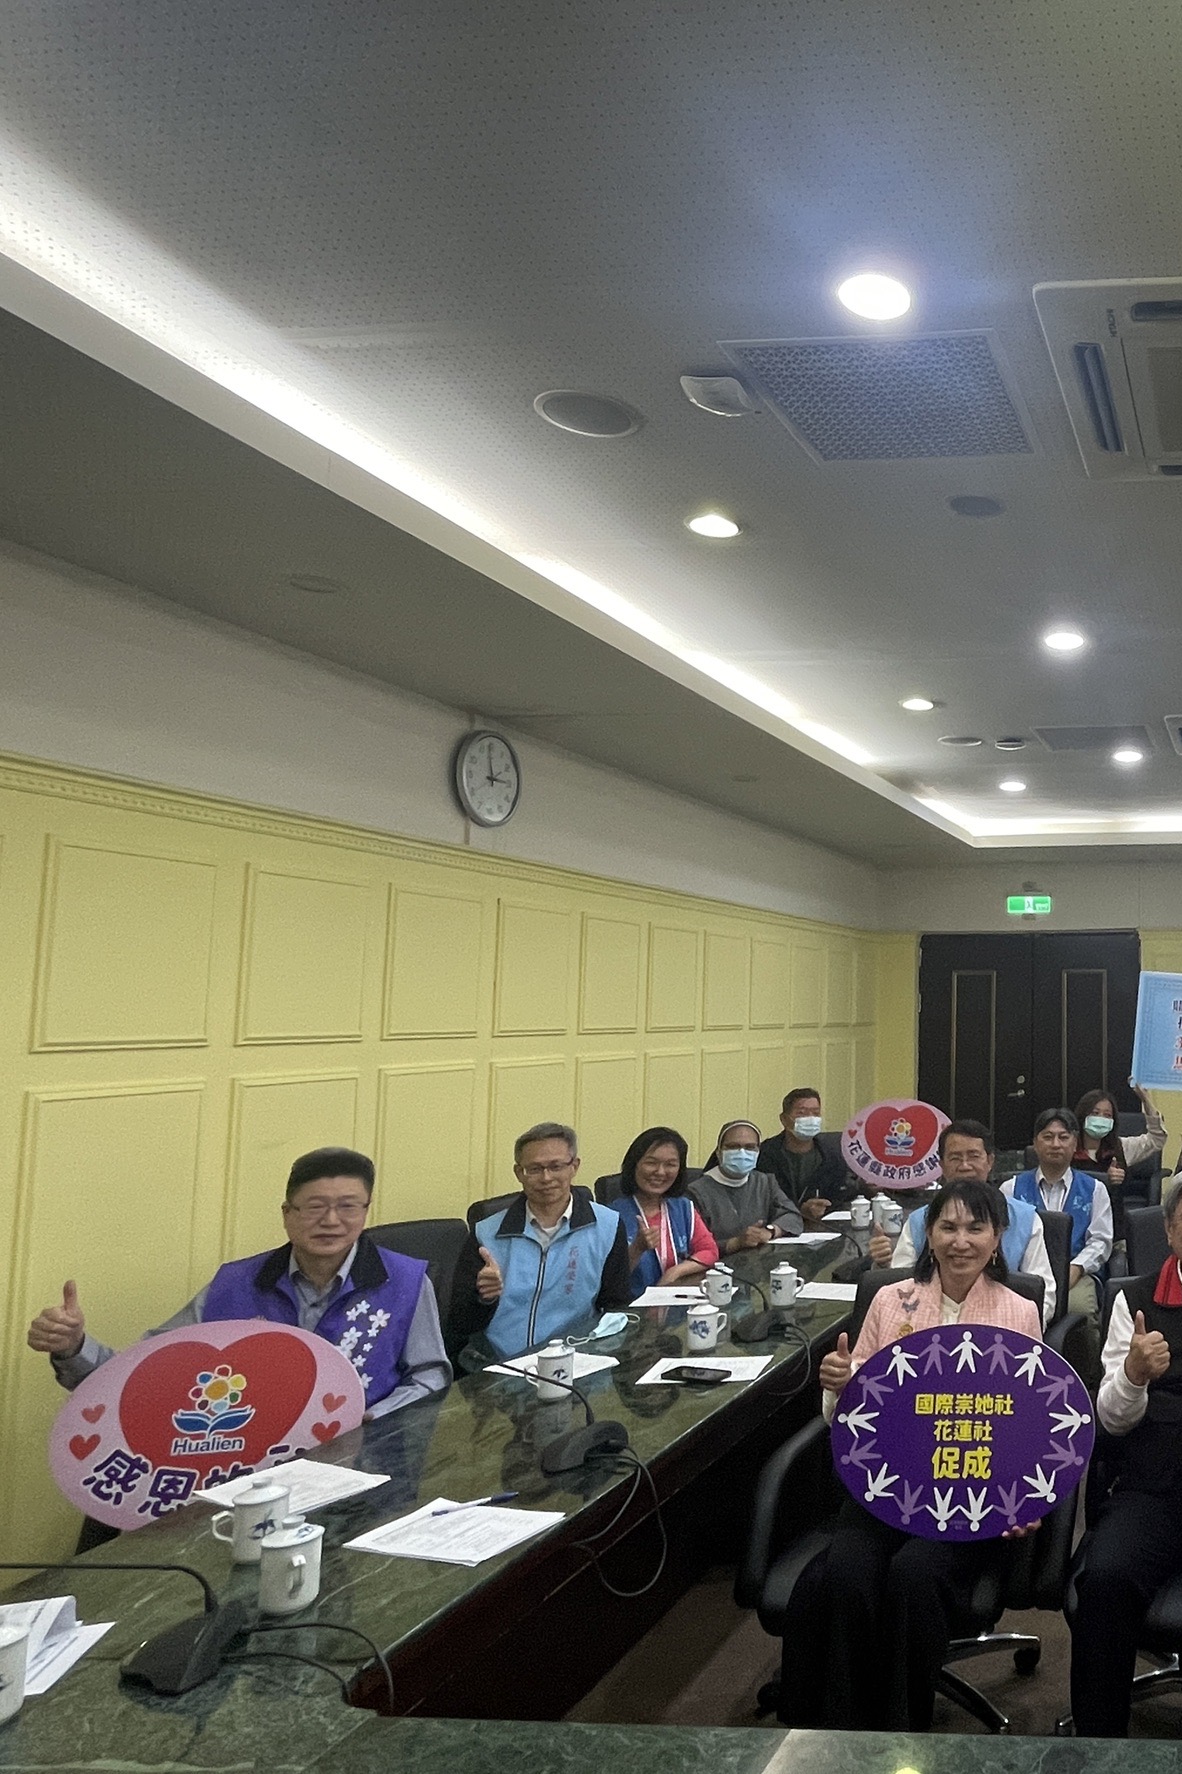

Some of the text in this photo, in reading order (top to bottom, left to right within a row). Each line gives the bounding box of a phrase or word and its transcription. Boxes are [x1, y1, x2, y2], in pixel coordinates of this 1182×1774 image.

[847, 1139, 941, 1180] 花蓮縣政府感謝
[915, 1393, 1014, 1415] 國際崇她社
[933, 1419, 993, 1441] 花蓮社
[172, 1435, 244, 1455] Hualien
[931, 1446, 993, 1480] 促成
